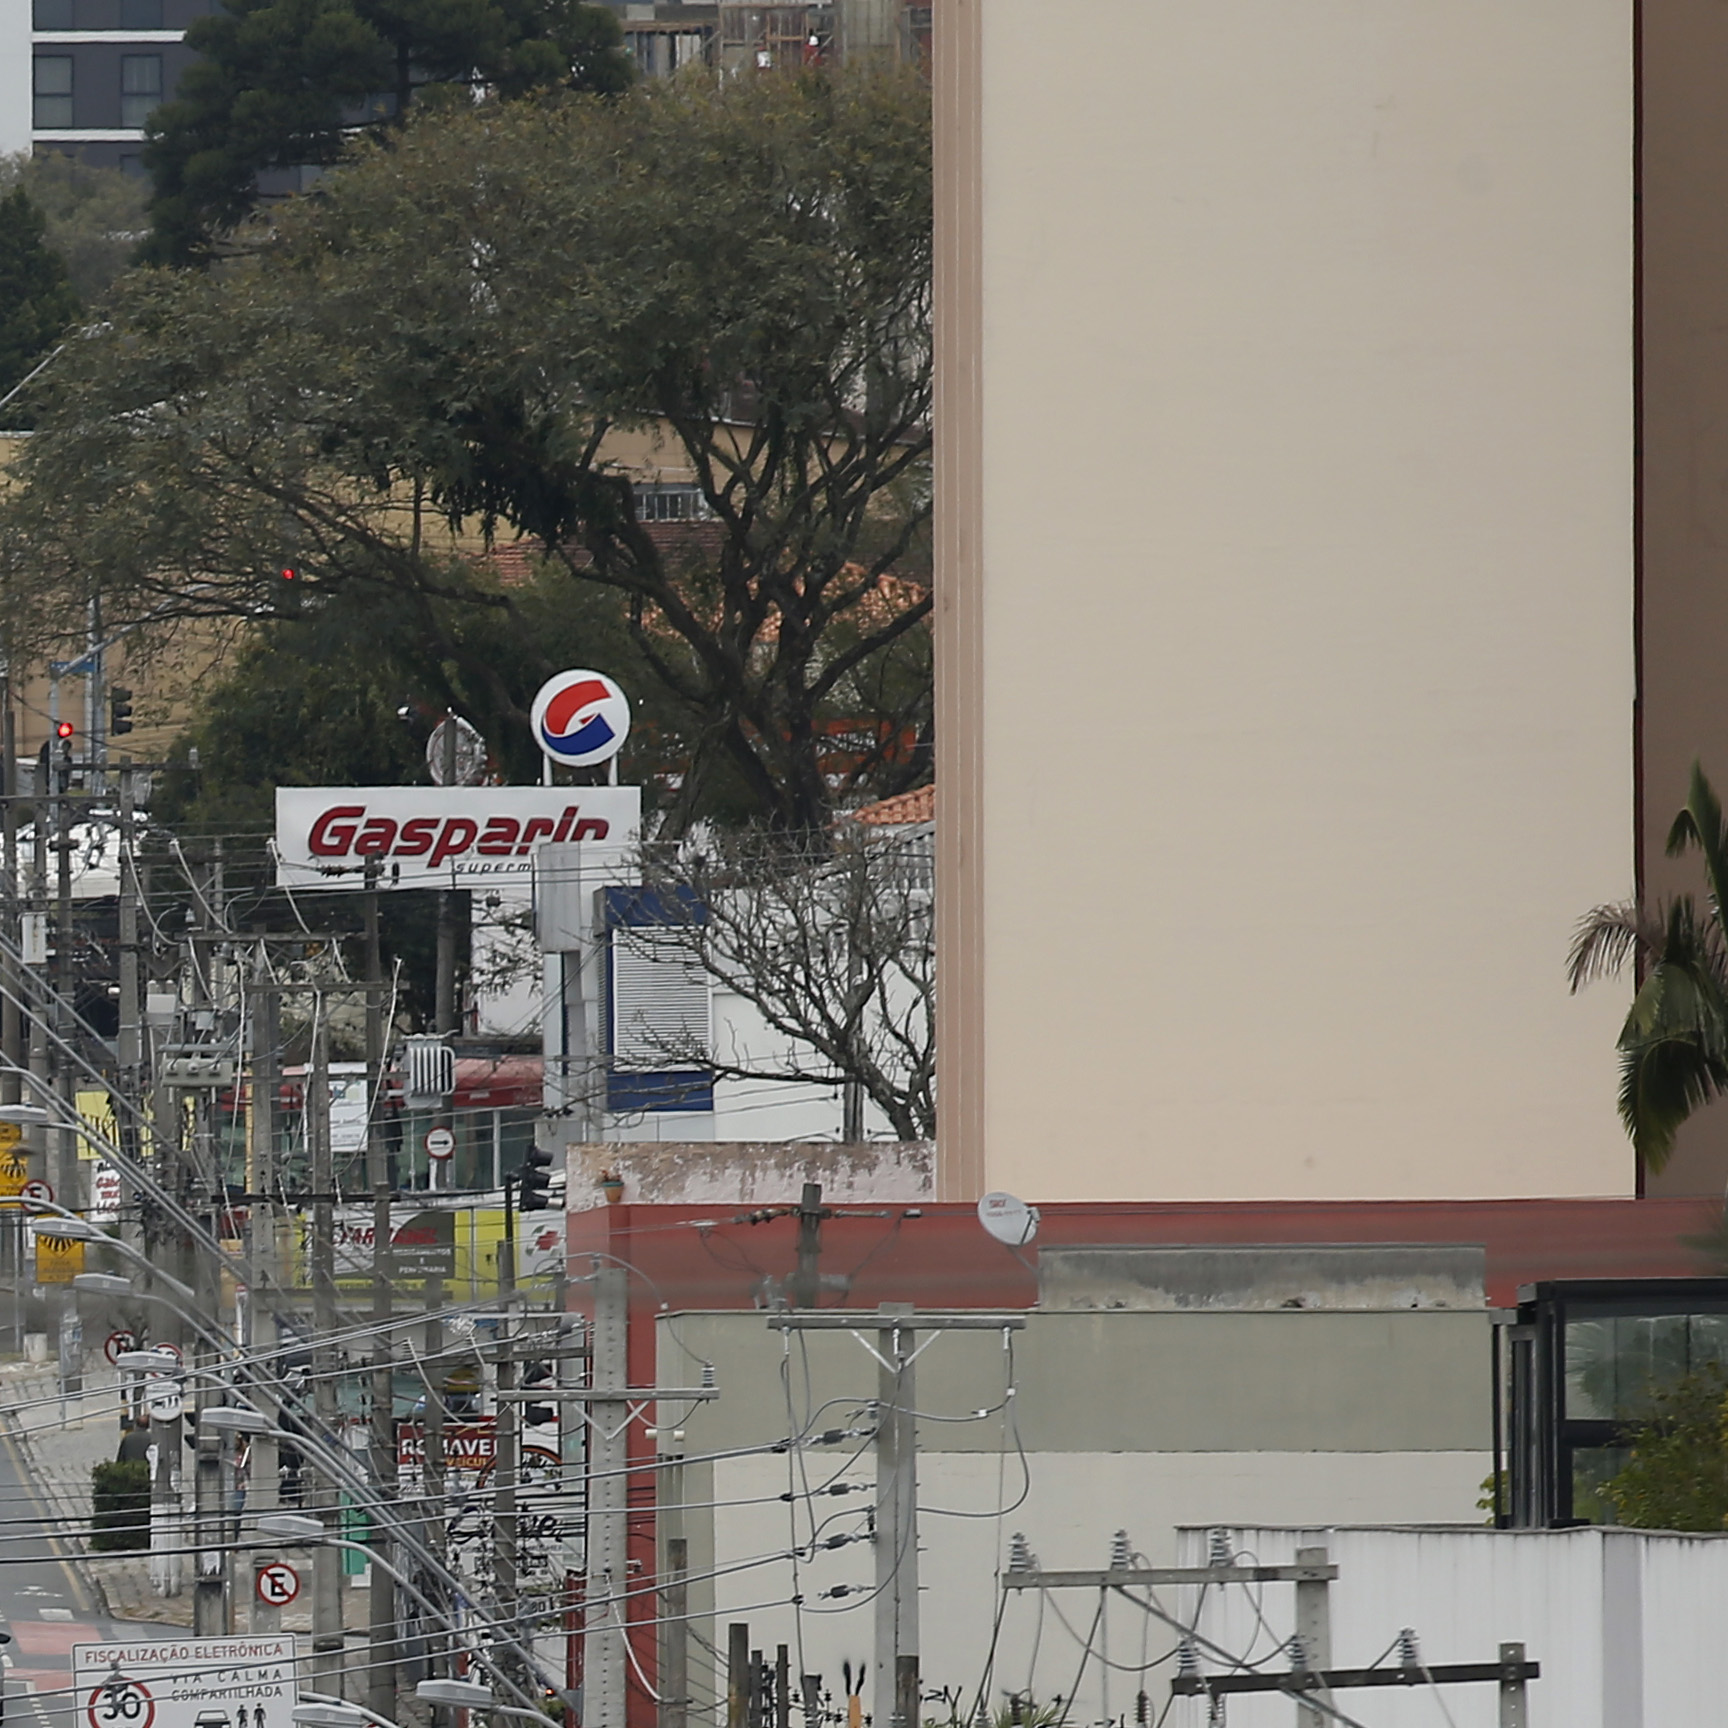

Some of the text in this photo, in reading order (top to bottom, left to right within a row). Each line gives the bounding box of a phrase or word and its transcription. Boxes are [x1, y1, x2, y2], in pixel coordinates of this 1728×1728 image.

[308, 805, 610, 869] Gasparin
[270, 1573, 284, 1598] E
[85, 1641, 284, 1664] FISCALIZAÇÃO ELETRÔNICA
[172, 1668, 283, 1685] VIA CALMA
[102, 1691, 141, 1721] 30
[171, 1686, 284, 1702] COMPARTILHADA
